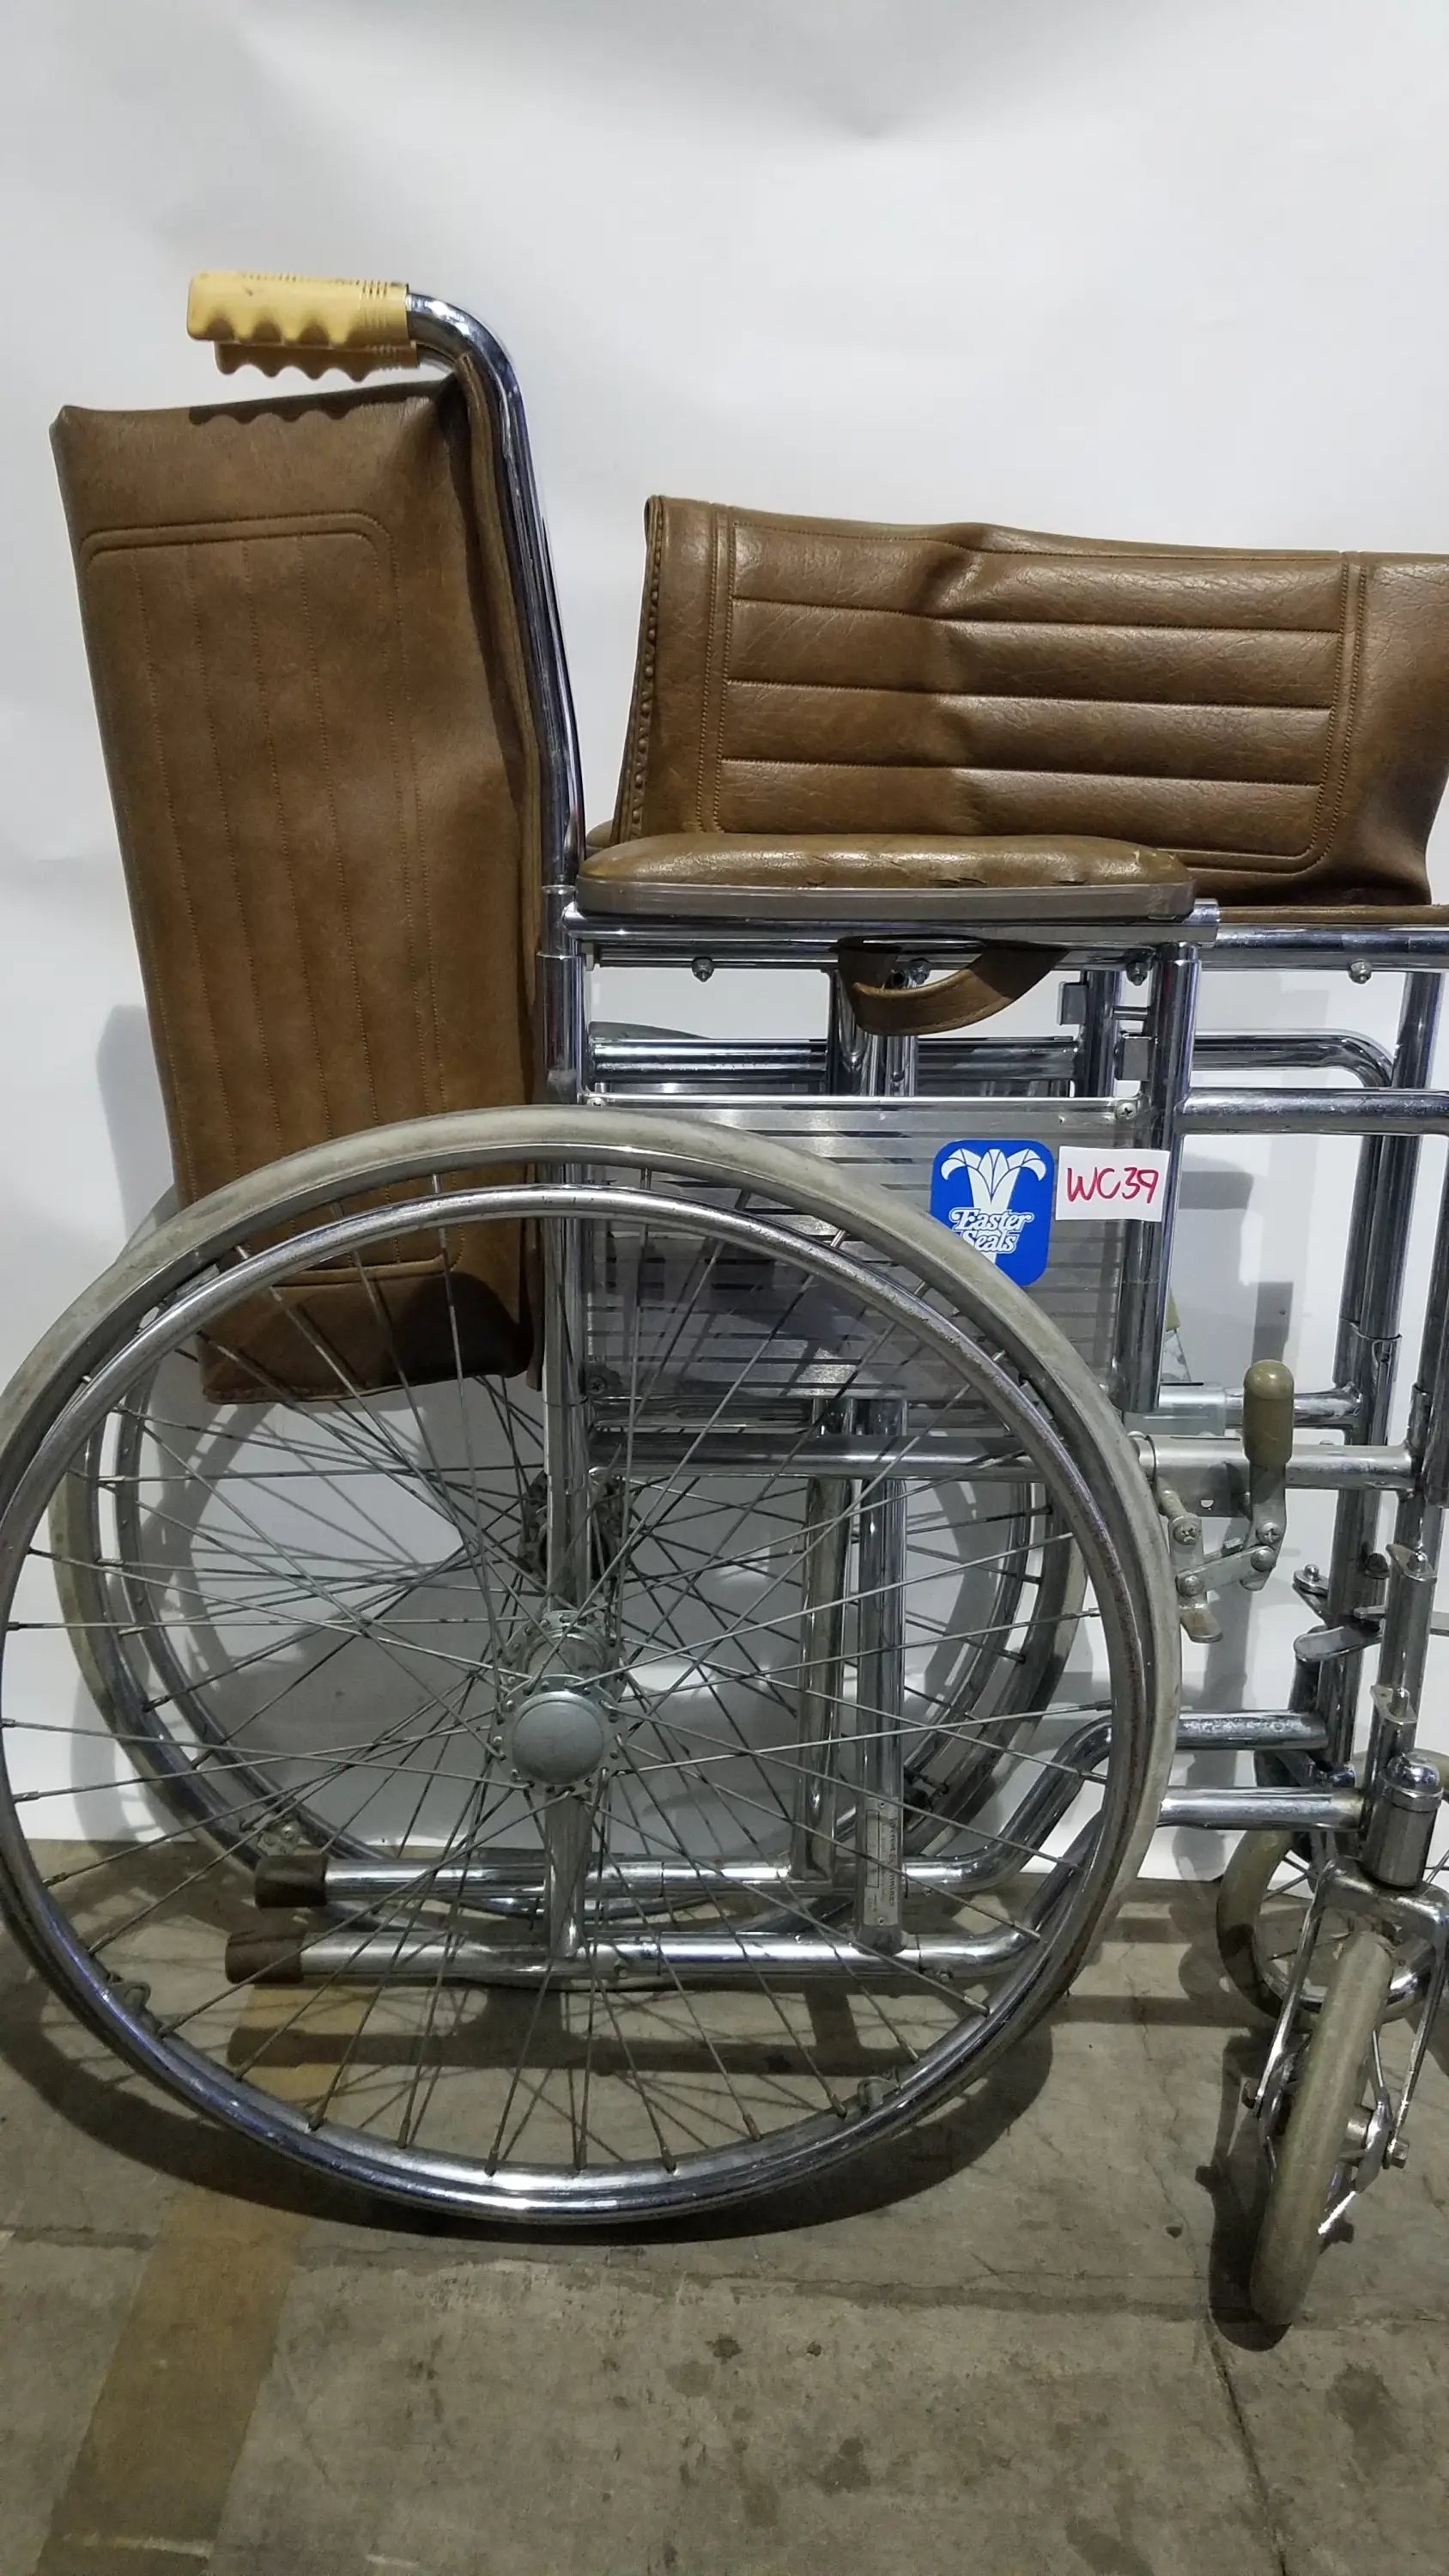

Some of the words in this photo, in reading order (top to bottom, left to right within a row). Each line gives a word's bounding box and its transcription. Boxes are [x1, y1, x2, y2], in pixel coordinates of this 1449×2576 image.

[1066, 1166, 1159, 1204] WC39
[949, 1208, 1034, 1231] Easter
[961, 1229, 1017, 1253] Seals
